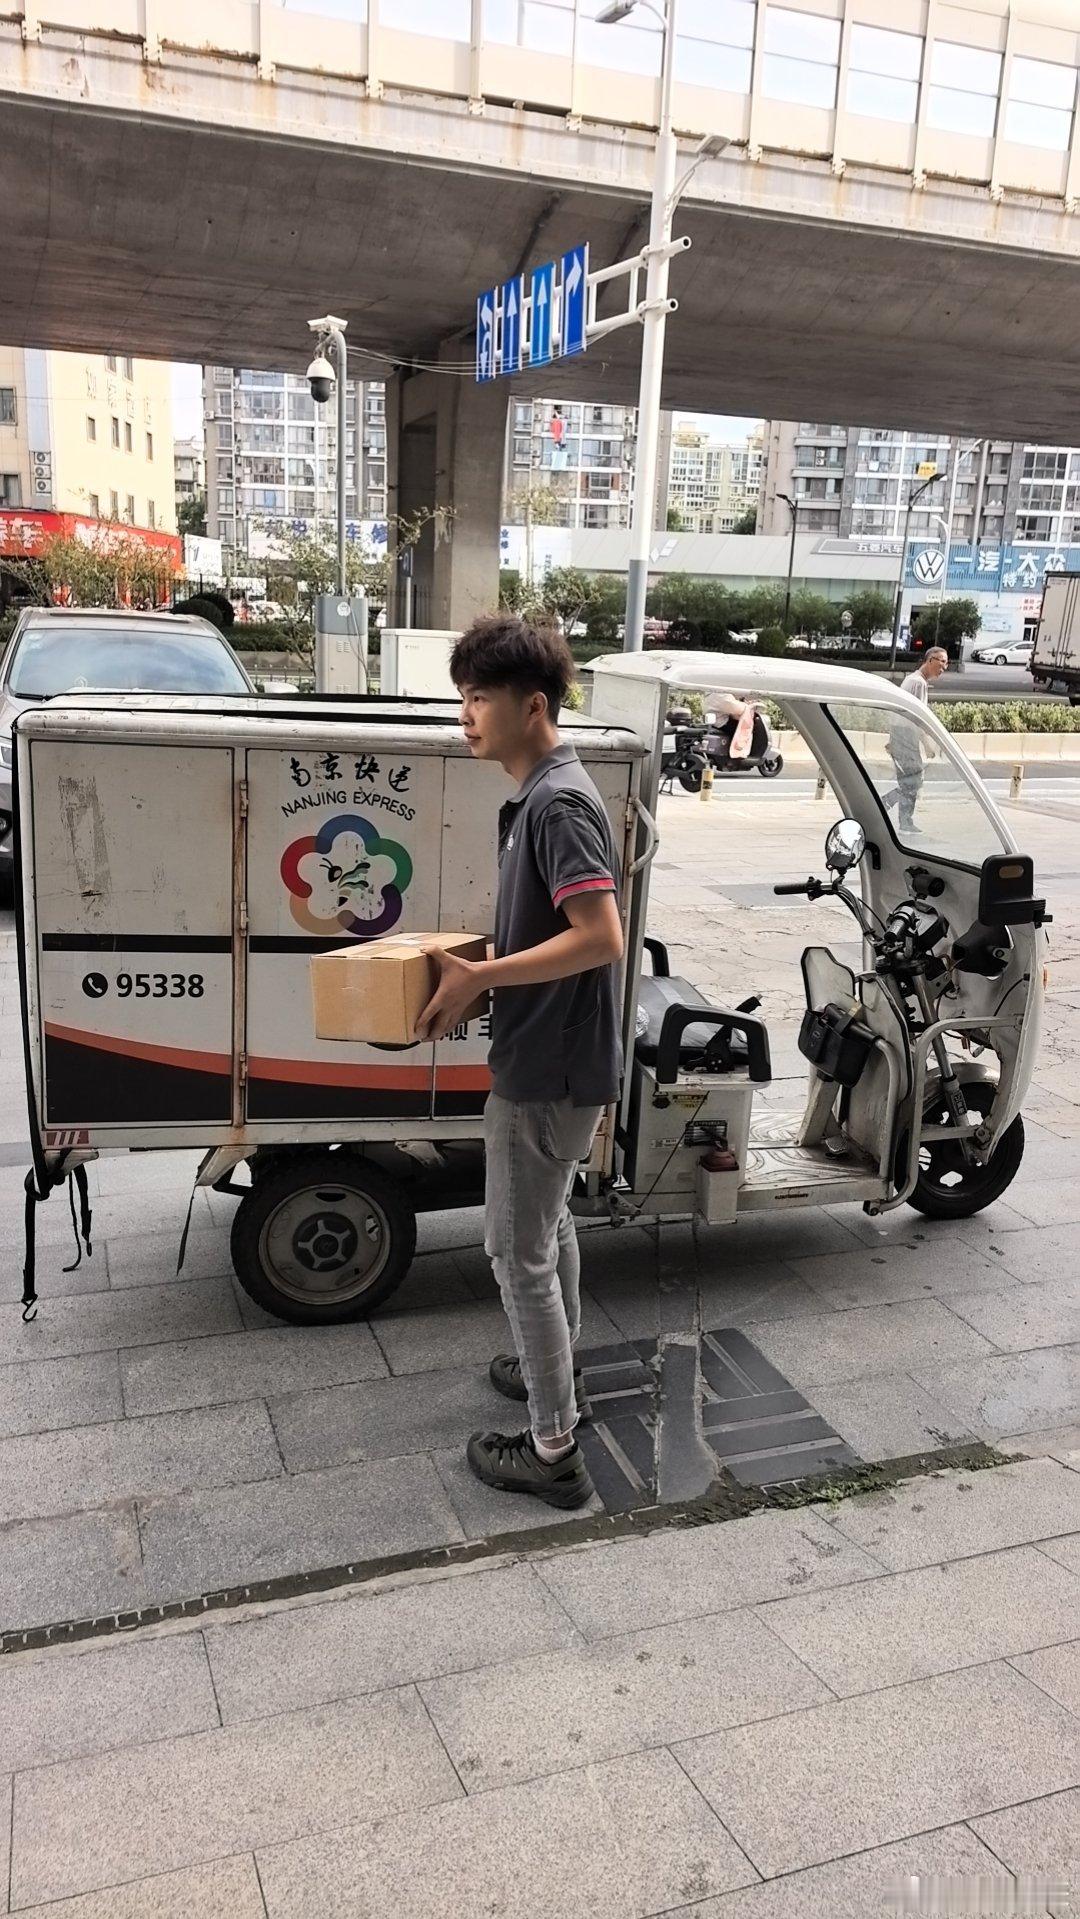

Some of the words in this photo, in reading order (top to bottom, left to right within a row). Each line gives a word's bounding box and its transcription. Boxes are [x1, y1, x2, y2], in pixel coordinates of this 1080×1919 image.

[1002, 571, 1047, 588] 特约
[289, 752, 412, 793] 南京快递
[281, 790, 347, 818] NANJING
[353, 791, 416, 821] EXPRESS
[116, 973, 205, 998] 95338
